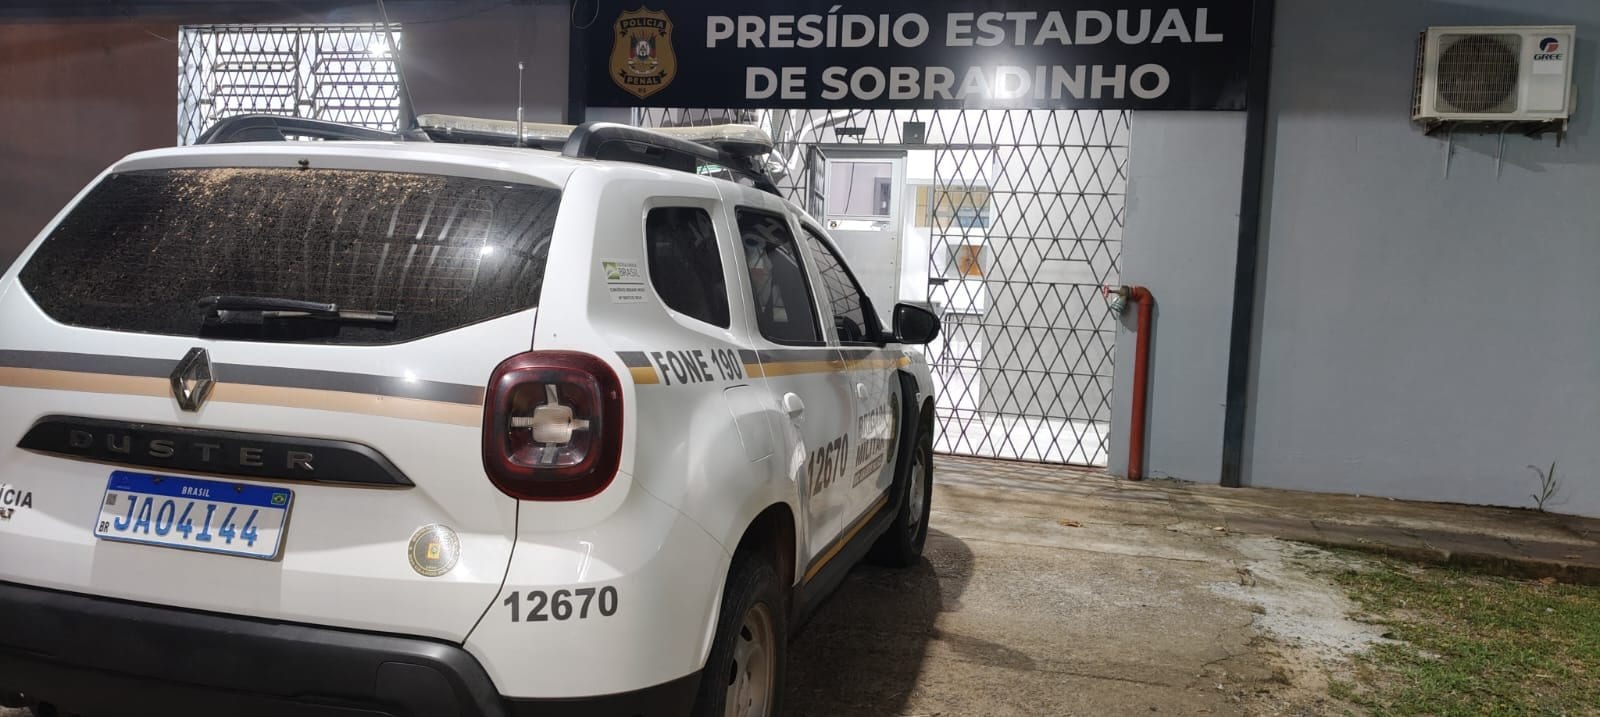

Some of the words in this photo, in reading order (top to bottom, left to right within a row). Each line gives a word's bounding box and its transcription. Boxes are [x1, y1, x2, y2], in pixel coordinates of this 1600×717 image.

[621, 17, 665, 29] POLÍCIA
[706, 5, 929, 48] PRESÍDIO
[945, 8, 1224, 47] ESTADUAL
[1534, 53, 1563, 61] GREE
[626, 77, 659, 86] PENAL
[745, 66, 807, 99] DE
[820, 63, 1170, 101] SOBRADINHO
[650, 350, 714, 386] FONE
[711, 348, 742, 380] 190
[70, 430, 315, 472] DUSTER
[808, 432, 848, 500] 12670
[181, 485, 210, 498] BRASIL
[98, 521, 110, 533] BR
[503, 585, 619, 623] 12670
